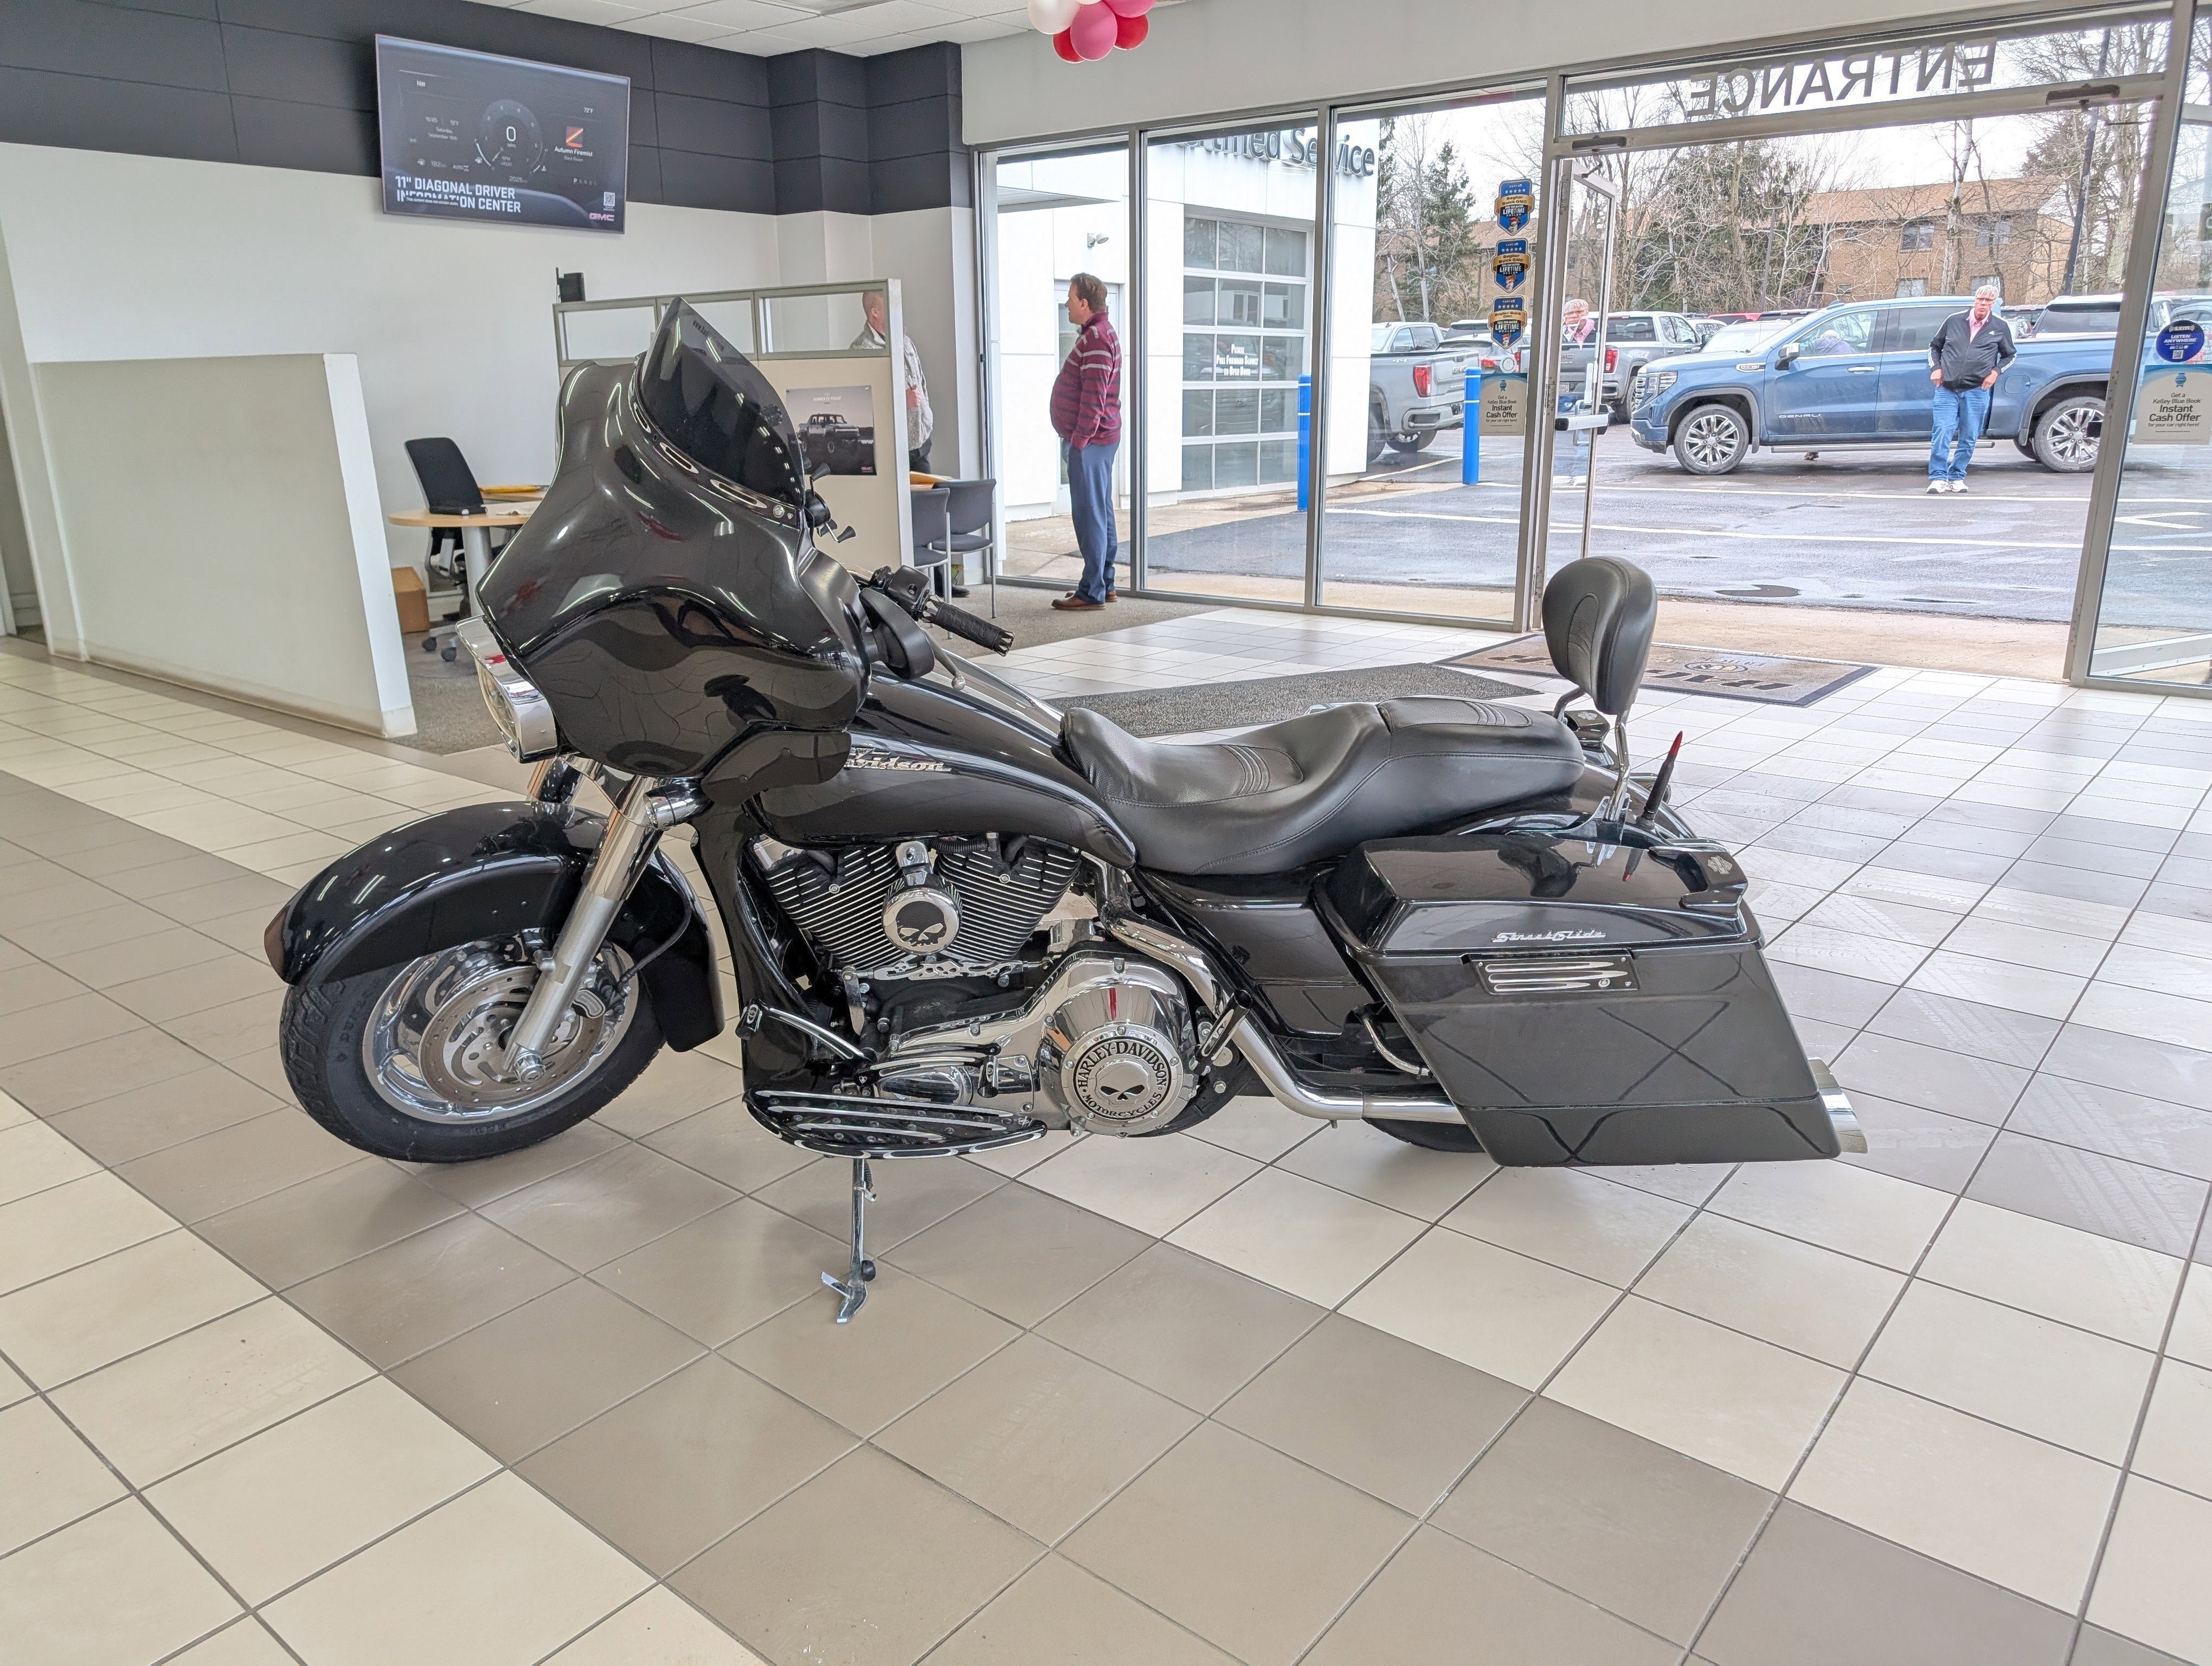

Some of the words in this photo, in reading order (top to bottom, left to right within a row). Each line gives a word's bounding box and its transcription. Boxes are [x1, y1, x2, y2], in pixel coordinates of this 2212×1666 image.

[506, 126, 516, 142] 0
[574, 149, 593, 157] Firemist
[1287, 128, 1375, 176] Sevice
[414, 177, 473, 195] DIAGONAL
[475, 184, 516, 200] DRIVER
[478, 198, 521, 213] CENTER
[589, 213, 615, 221] GMC
[2159, 405, 2194, 413] Instant
[2149, 413, 2173, 421] Cash
[2176, 413, 2201, 421] Offer
[1077, 1041, 1167, 1088] HARLEY-DAVIDSON
[1082, 1092, 1162, 1117] MOTORCYCLES
